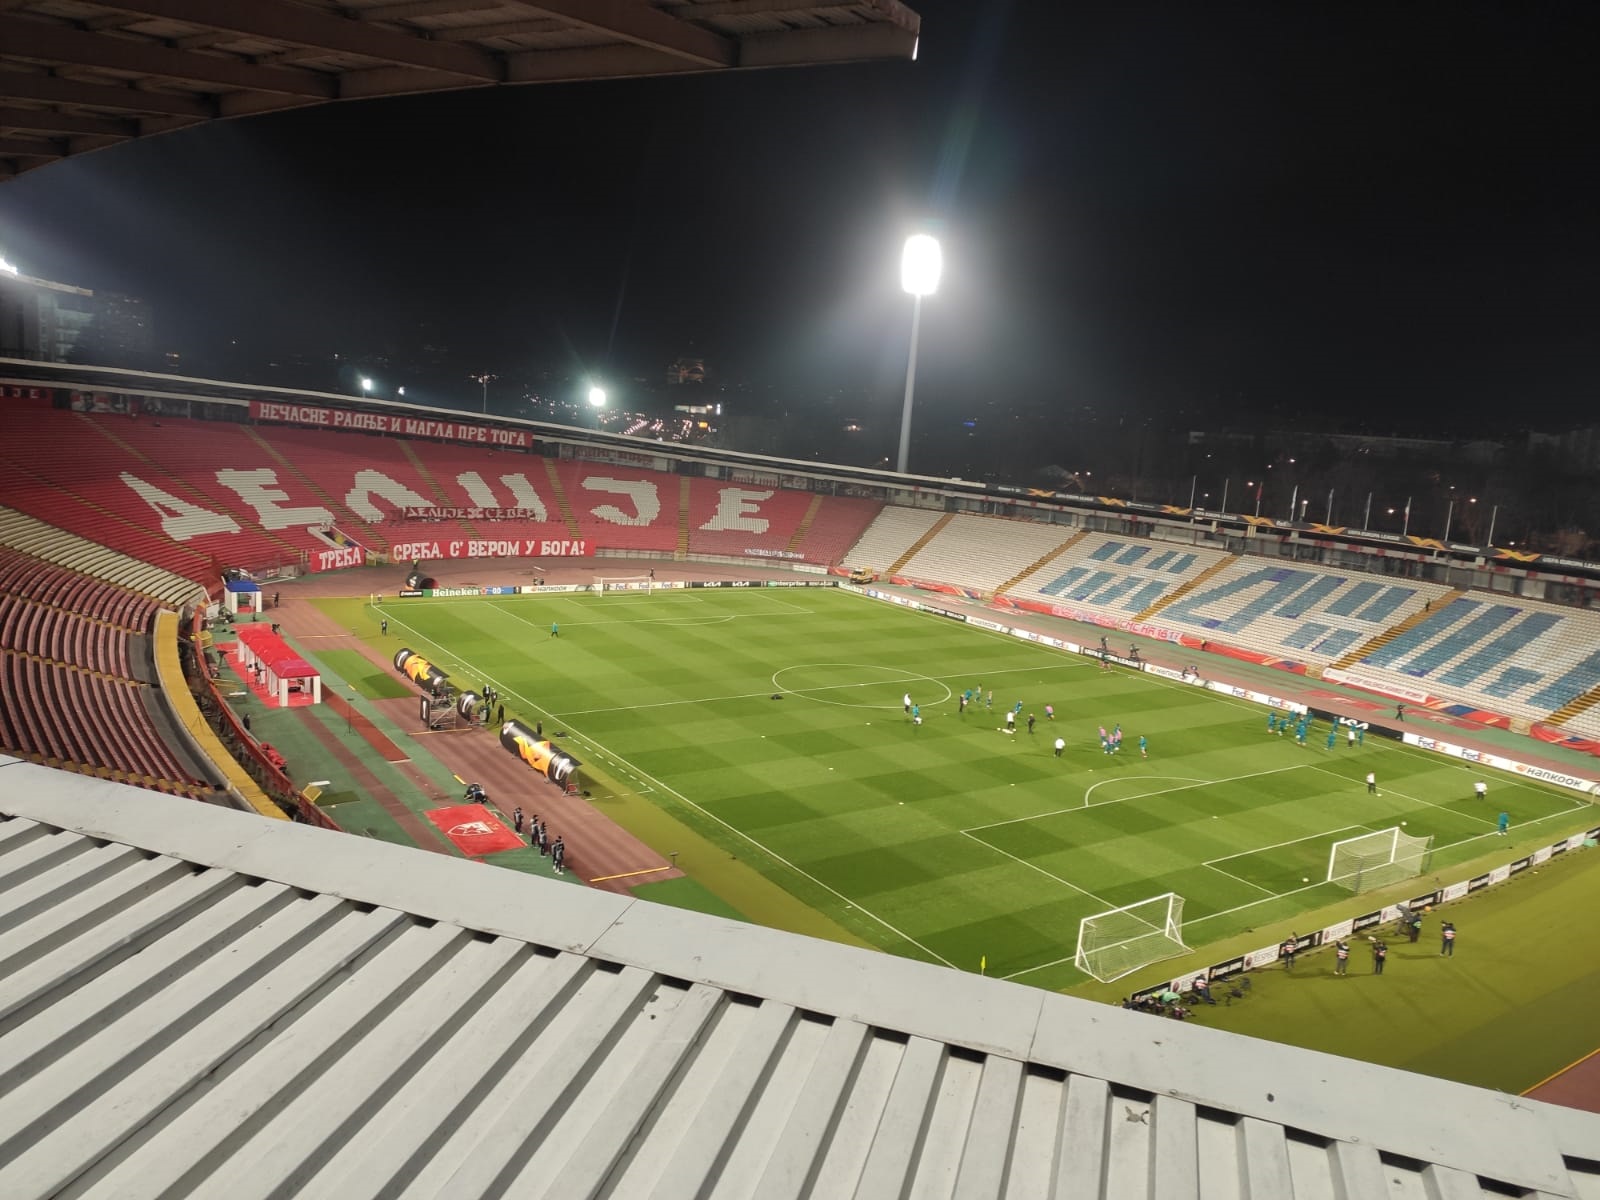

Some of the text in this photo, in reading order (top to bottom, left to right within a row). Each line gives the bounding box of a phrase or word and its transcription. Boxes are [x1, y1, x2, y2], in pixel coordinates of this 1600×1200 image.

[258, 402, 526, 446] НЕЧАСНЕ РАДЊЕ И МАГЛА ПРЕ ТОГА
[467, 540, 520, 557] ВЕРОМ
[525, 540, 535, 556] У
[540, 540, 586, 556] БОГА!
[319, 546, 362, 570] ТРЕЋА
[432, 587, 479, 597] Heineken
[1418, 736, 1447, 752] FedEx
[1461, 749, 1493, 765] FedEx
